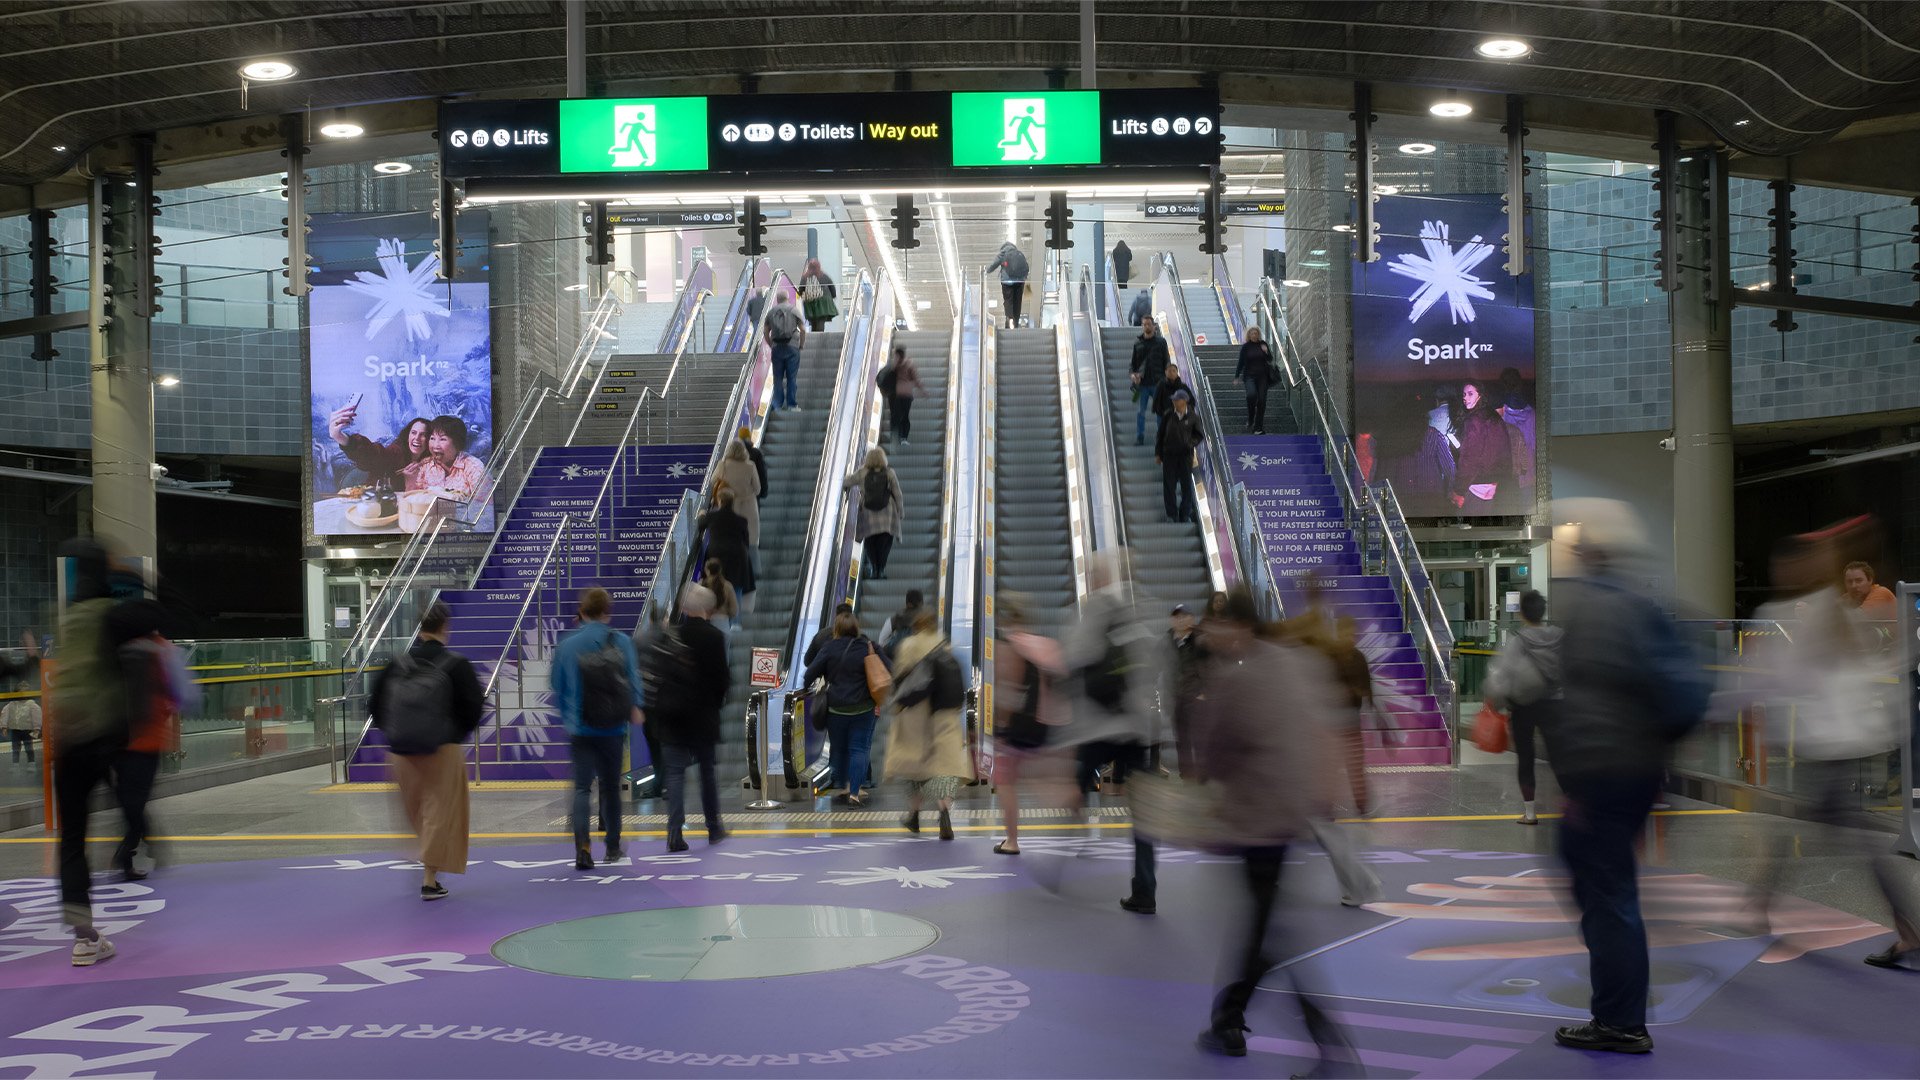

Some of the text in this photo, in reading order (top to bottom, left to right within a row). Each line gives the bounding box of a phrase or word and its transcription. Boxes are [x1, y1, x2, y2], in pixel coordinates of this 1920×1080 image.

[800, 123, 939, 140] Toilets Way out
[1112, 119, 1148, 135] Lifts
[514, 130, 549, 145] Lifts
[1177, 205, 1200, 213] Toilets
[1259, 204, 1274, 212] Way
[680, 213, 702, 221] Toilets
[1407, 337, 1480, 365] Spark
[363, 354, 436, 382] Spark
[1260, 456, 1287, 466] Spark
[582, 468, 608, 477] Spark
[688, 466, 707, 475] Spar
[1272, 488, 1301, 496] MEMES
[1315, 532, 1347, 540] REPEAT
[1295, 556, 1323, 564] CHATS
[573, 872, 803, 885] Spark
